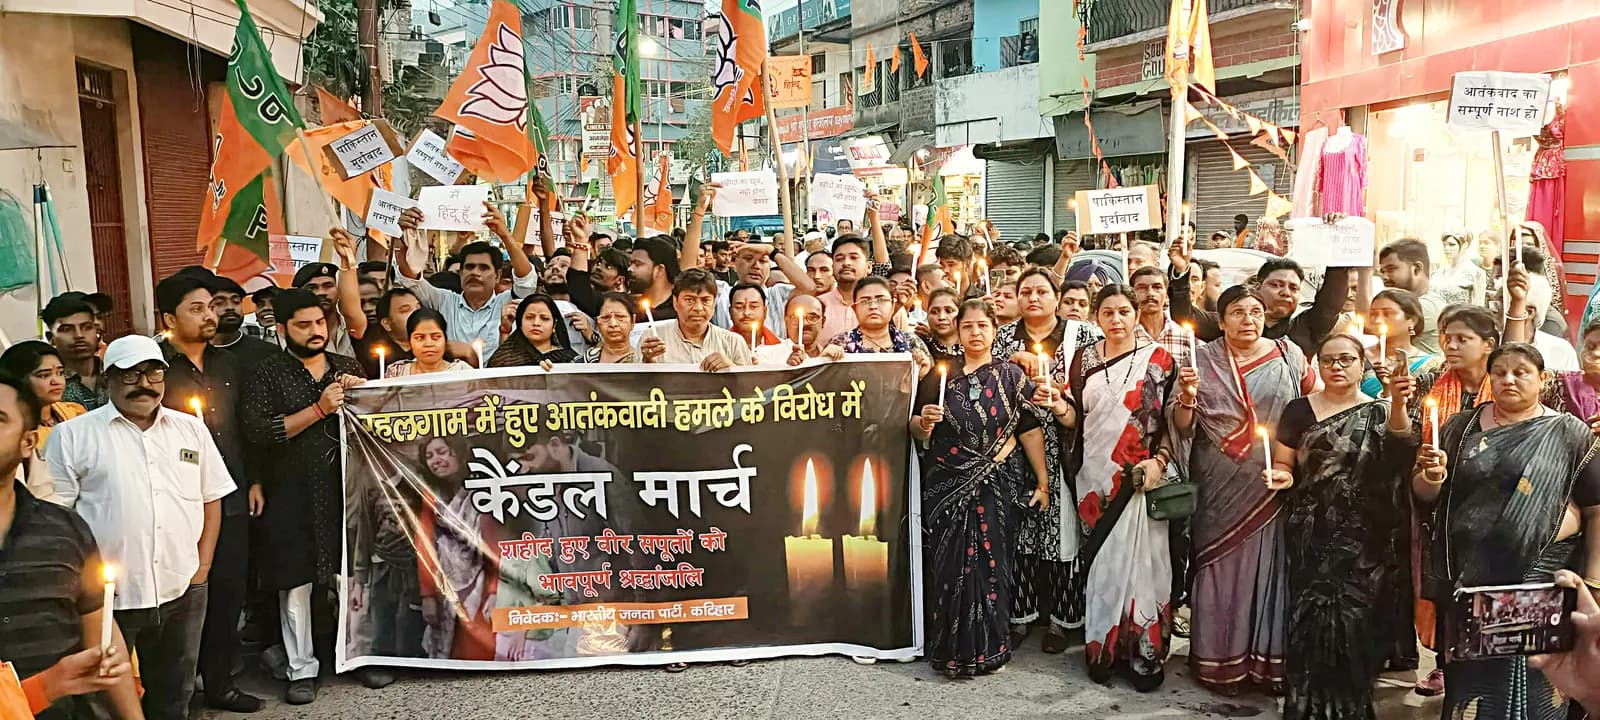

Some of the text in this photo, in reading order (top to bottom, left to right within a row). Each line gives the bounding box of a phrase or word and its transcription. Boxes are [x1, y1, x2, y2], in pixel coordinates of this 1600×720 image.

[1464, 85, 1538, 99] आतंकवाद का
[1458, 103, 1539, 119] सम्पूर्ण नाश हो
[337, 130, 378, 154] पाकिस्तान
[1092, 193, 1144, 206] पाकिस्तान
[474, 394, 500, 433] में
[503, 403, 540, 447] हुए
[546, 388, 668, 431] आतंकवादी
[673, 387, 736, 432] हमले
[740, 386, 766, 424] के
[772, 382, 835, 422] विरोध
[840, 380, 866, 419] में
[464, 444, 757, 524] कैंडल मार्च
[498, 527, 727, 563] शहीद हुए वीर सपूतों को
[539, 562, 704, 597] भावपूर्ण श्रद्धांजलि
[571, 606, 616, 621] भारतीय
[620, 609, 655, 620] जनता
[690, 602, 735, 617] कटिहार
